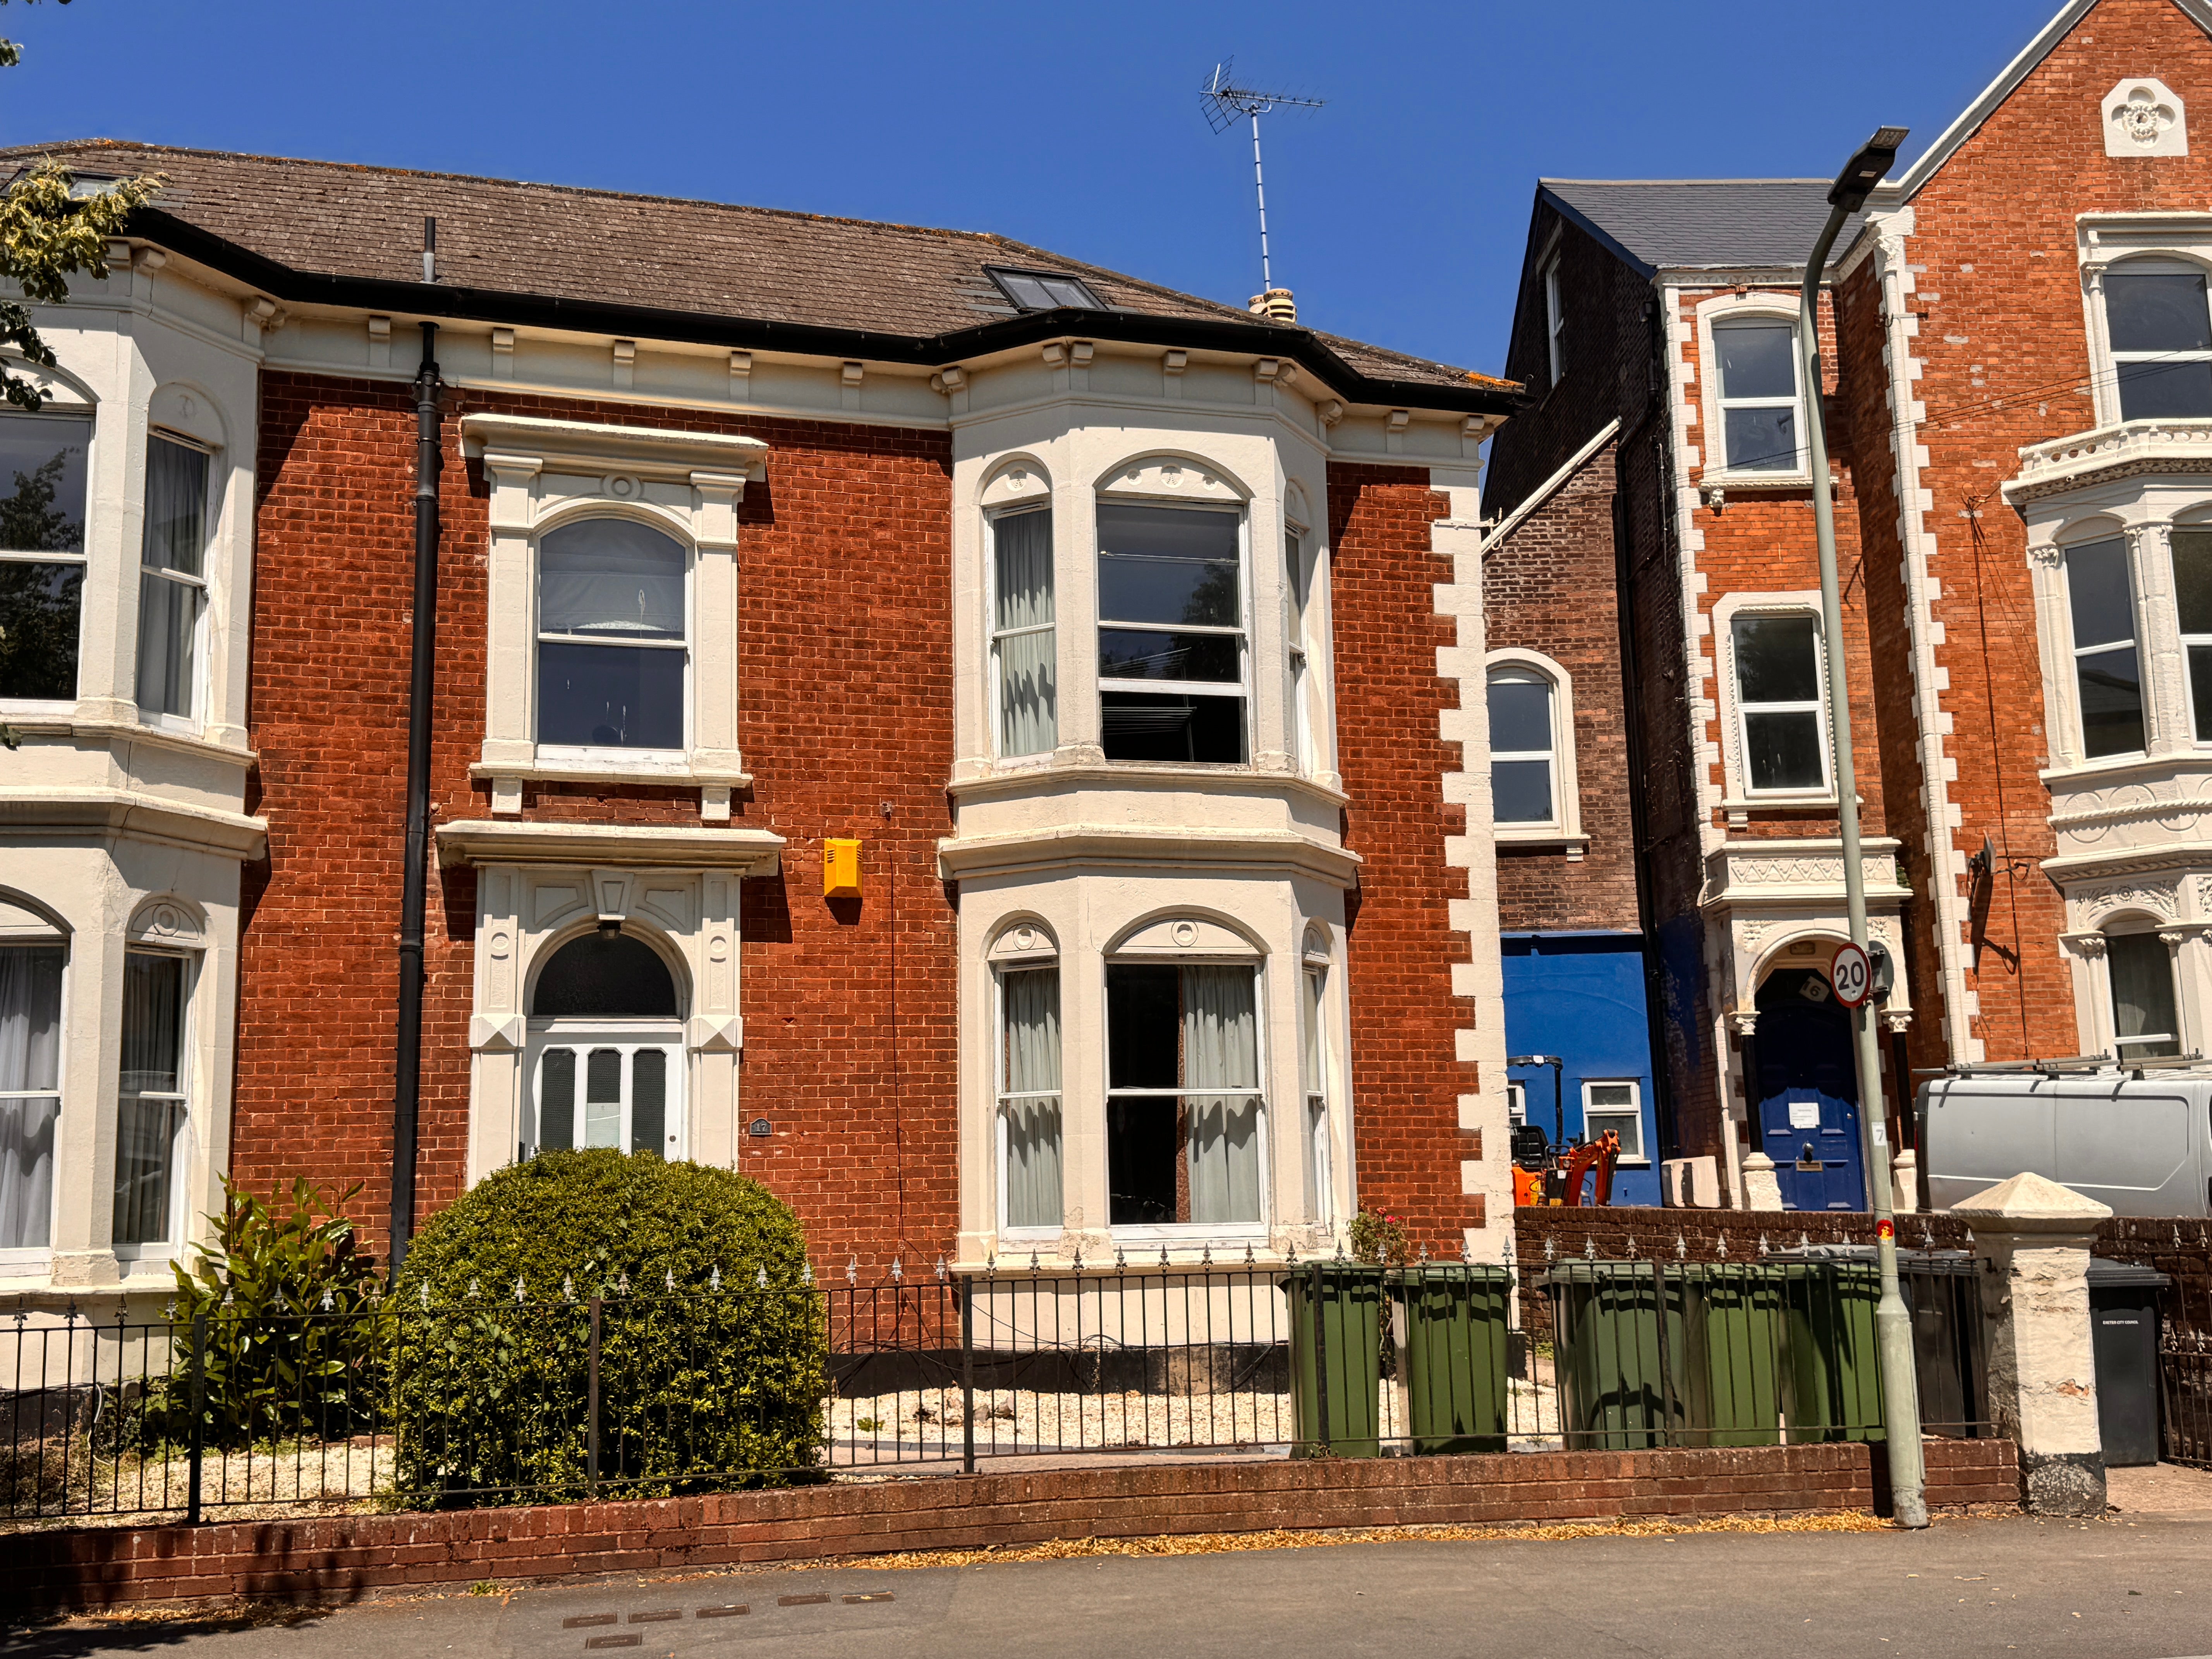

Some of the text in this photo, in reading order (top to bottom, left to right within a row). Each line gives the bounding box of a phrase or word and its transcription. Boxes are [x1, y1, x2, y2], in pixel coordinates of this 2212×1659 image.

[1836, 961, 1864, 990] 20
[1803, 981, 1821, 996] 16
[1876, 1129, 1884, 1141] 7
